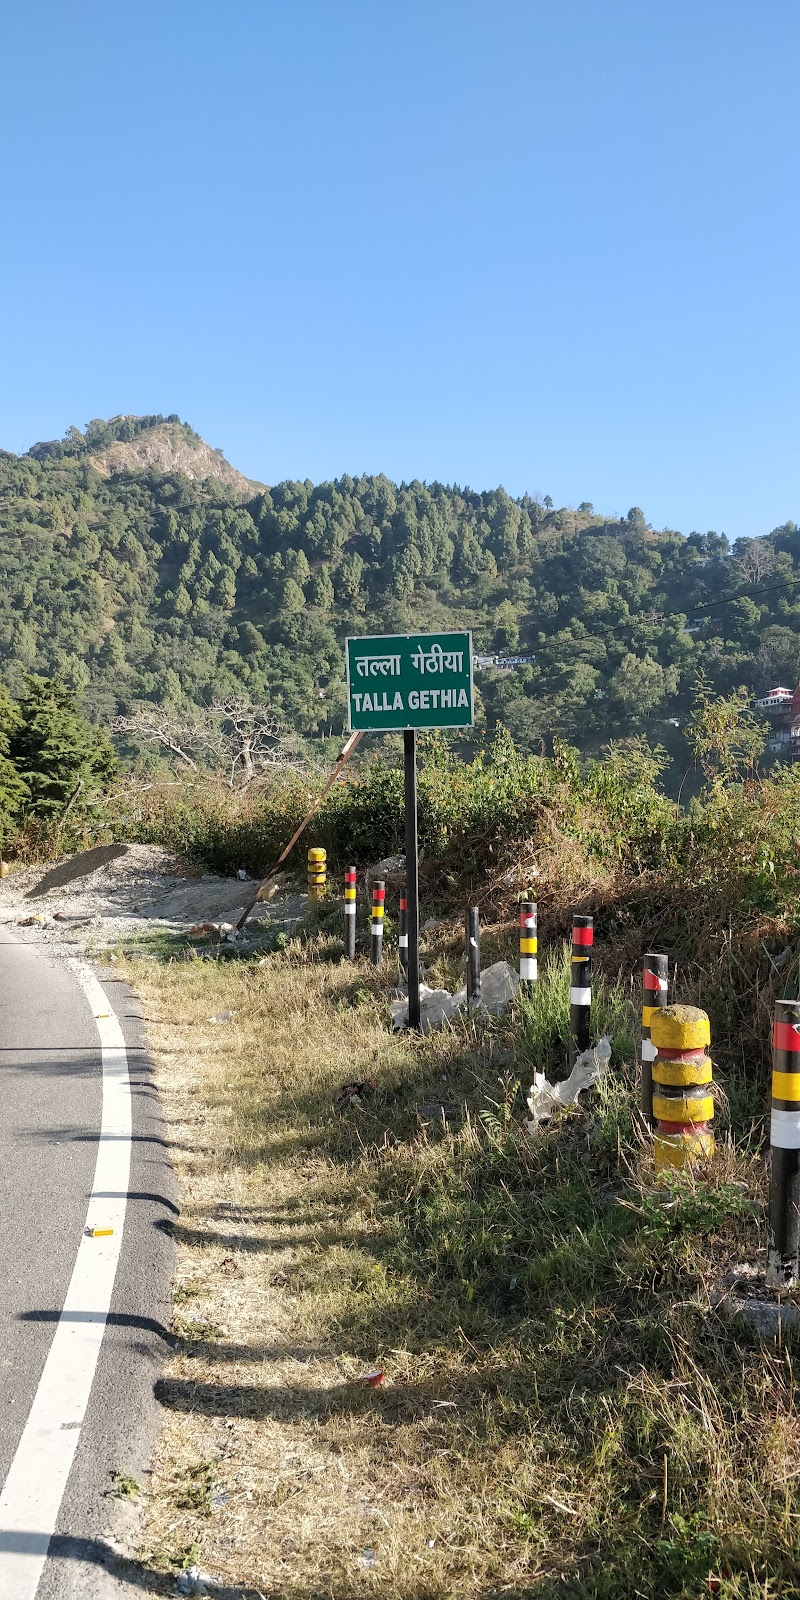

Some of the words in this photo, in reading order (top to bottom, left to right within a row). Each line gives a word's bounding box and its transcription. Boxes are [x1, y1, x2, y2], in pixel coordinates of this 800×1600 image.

[354, 654, 402, 677] तल्ला
[410, 643, 464, 675] गेठीया
[352, 691, 404, 712] TALLA
[408, 688, 469, 710] GETHIA
